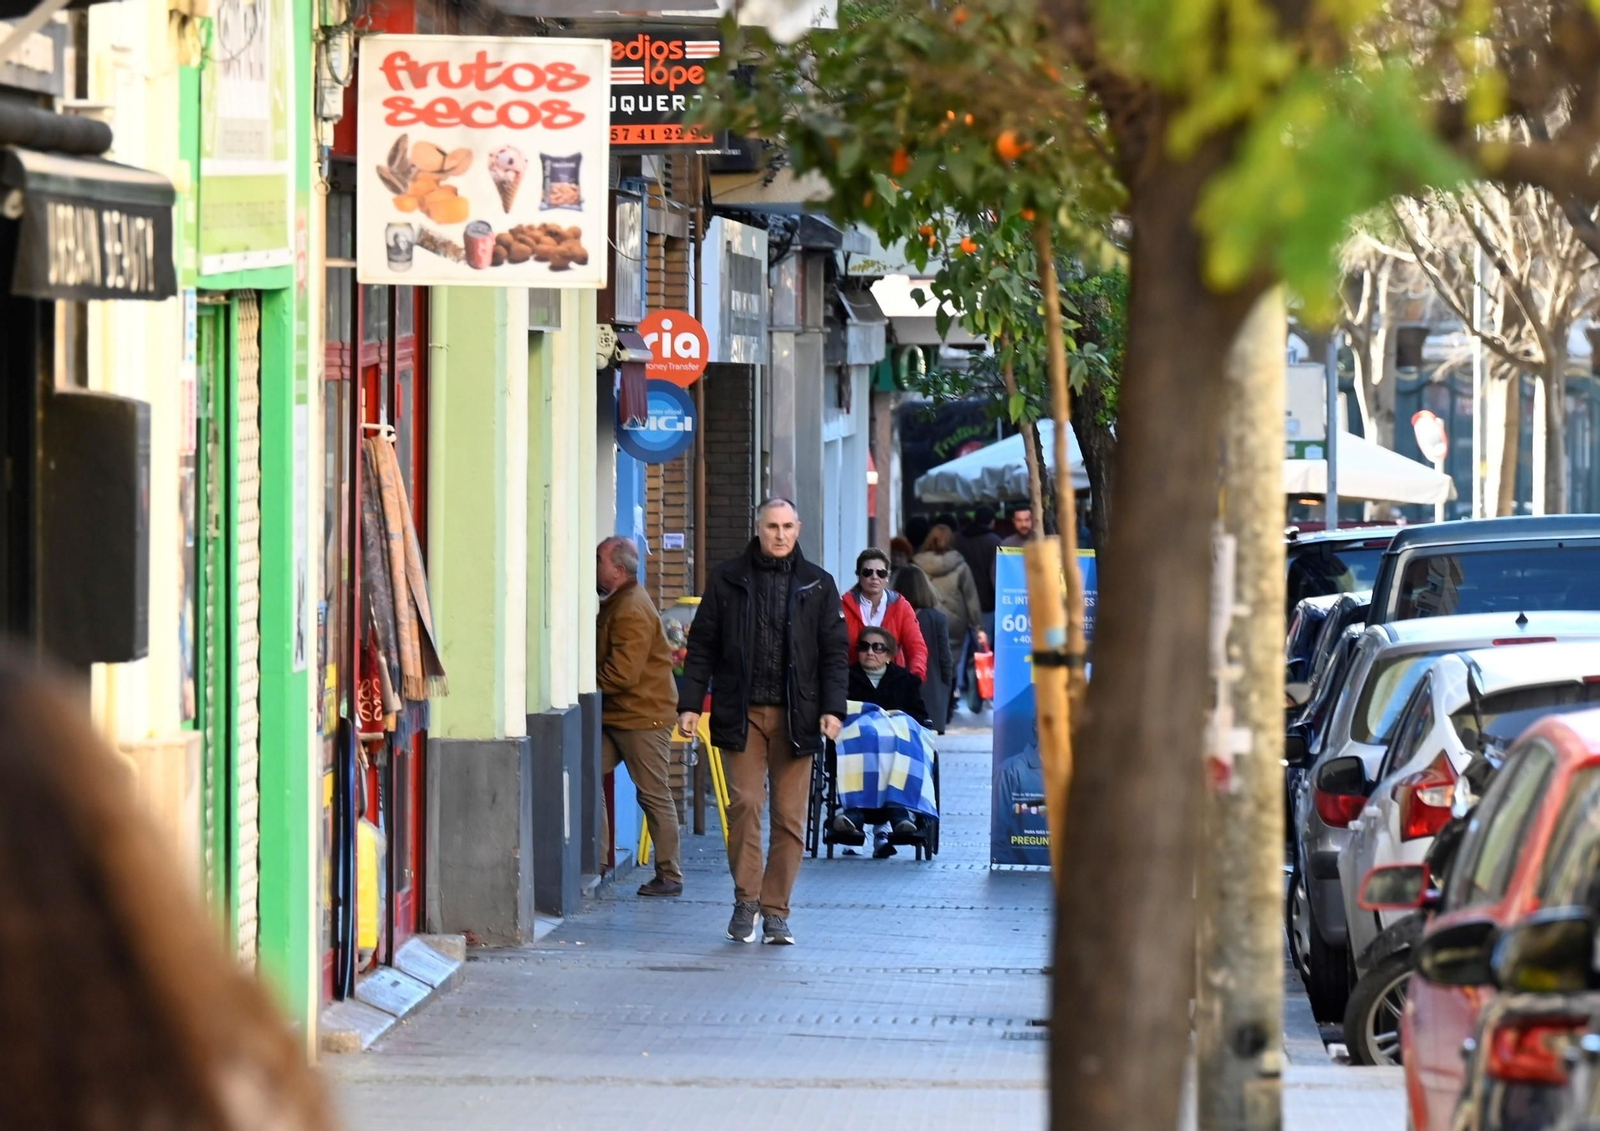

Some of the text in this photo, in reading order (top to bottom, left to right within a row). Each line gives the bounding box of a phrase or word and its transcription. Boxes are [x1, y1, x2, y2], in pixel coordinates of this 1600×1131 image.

[612, 34, 684, 60] edios
[379, 51, 590, 92] frutos
[383, 96, 586, 130] secos
[637, 128, 655, 140] 41
[664, 127, 684, 139] 22
[668, 362, 699, 371] Transfer
[1002, 614, 1031, 633] 60
[1011, 836, 1050, 845] PREGUN
